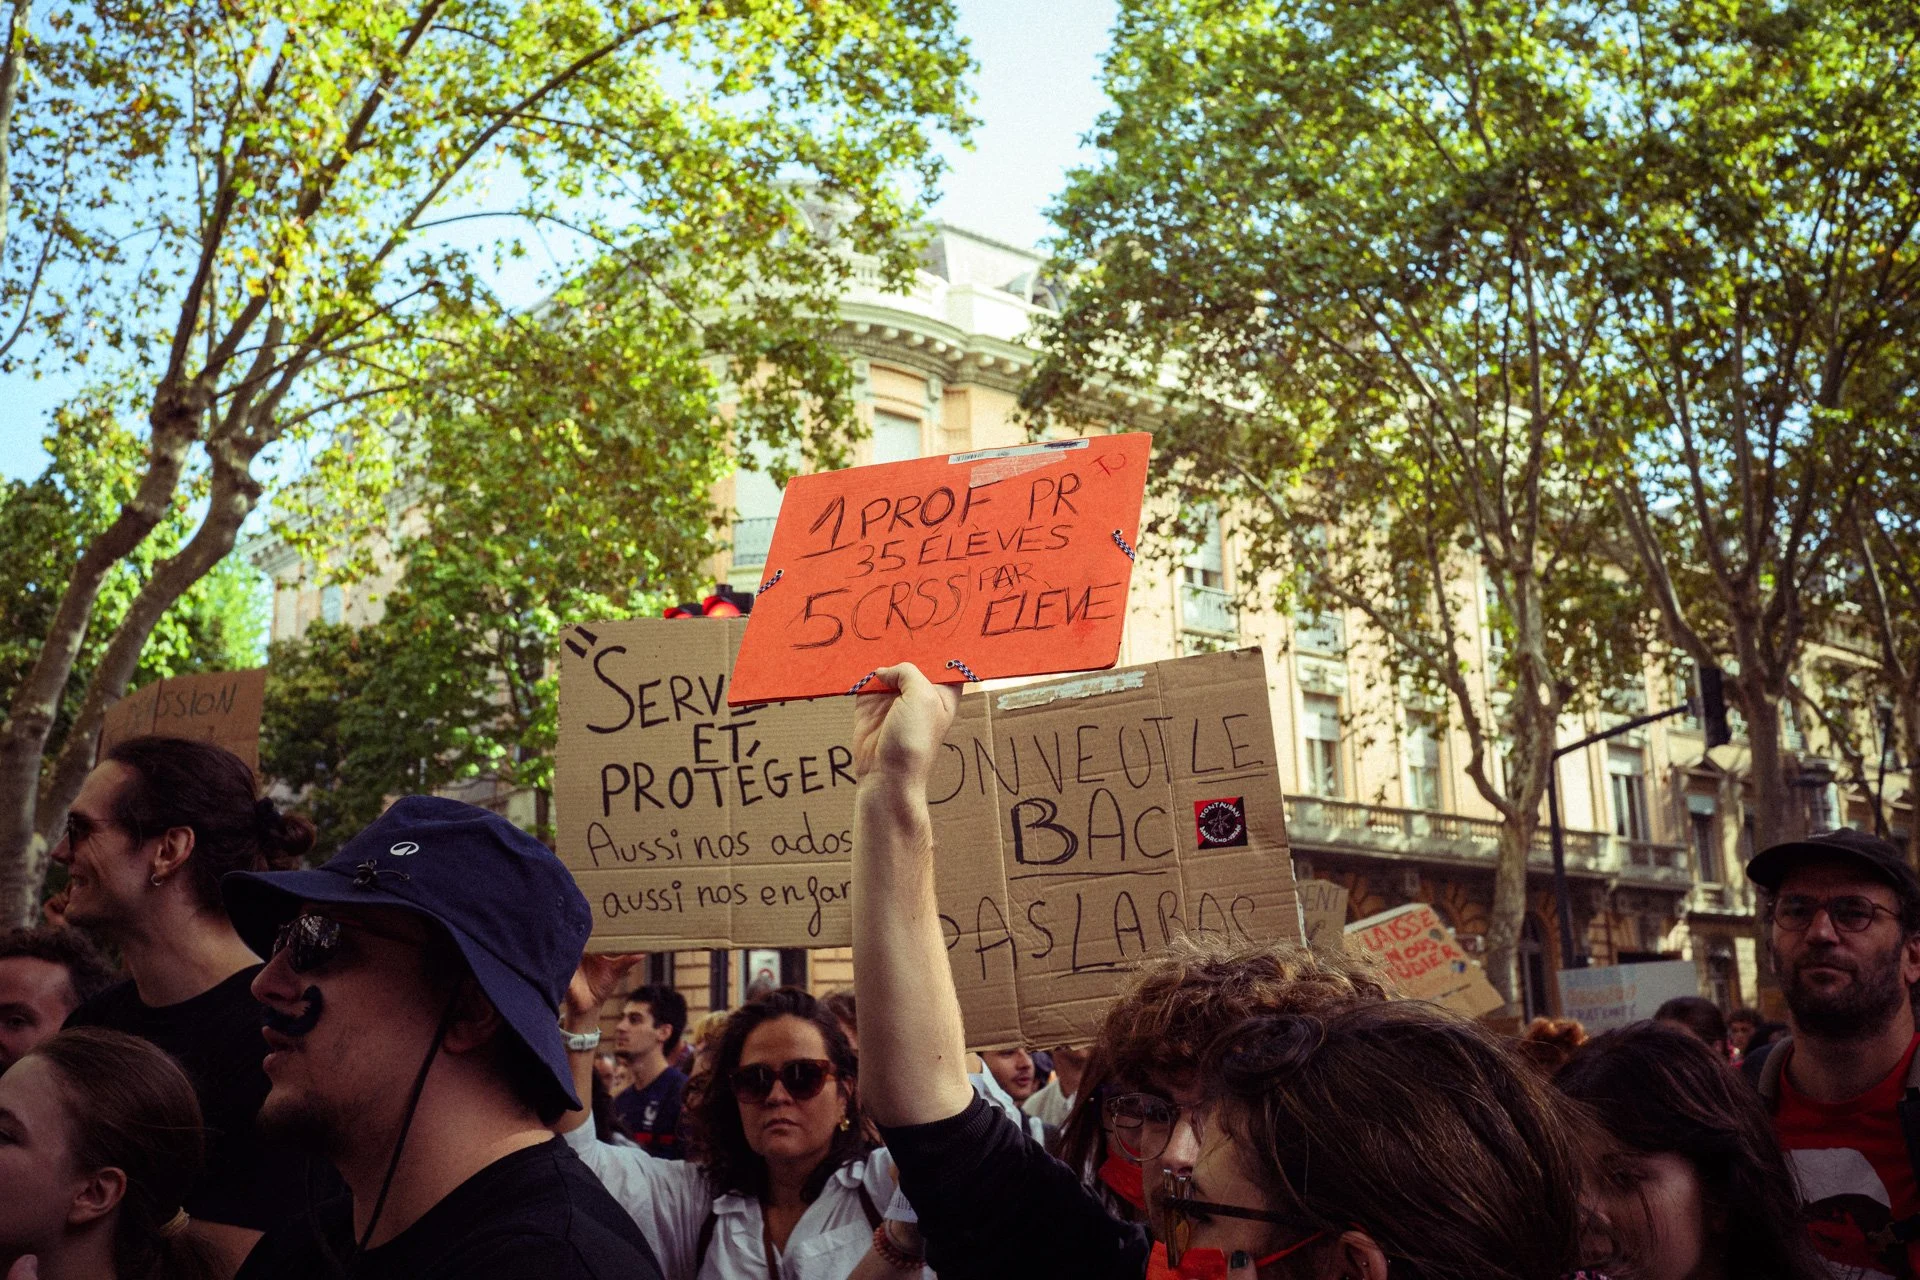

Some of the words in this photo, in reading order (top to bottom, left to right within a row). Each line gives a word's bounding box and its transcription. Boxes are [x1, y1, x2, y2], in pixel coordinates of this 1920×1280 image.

[795, 496, 856, 561] 1
[860, 480, 1003, 540] PROF
[1028, 473, 1082, 522] PR
[847, 539, 907, 579] 35
[917, 523, 1074, 566] ÉLÈVES
[786, 585, 852, 650] 5
[981, 581, 1122, 637] ÉLÈVE
[693, 720, 757, 765] ET
[1033, 715, 1174, 794] VEUT
[1192, 713, 1264, 775] LE
[601, 741, 857, 817] PROTÉGER
[1199, 801, 1241, 819] MONTAUBAN
[587, 822, 683, 867] Aussi
[694, 831, 750, 862] nos
[771, 811, 852, 856] ados
[1011, 787, 1175, 866] BAC
[603, 880, 684, 919] aussi
[697, 883, 748, 908] nos
[1072, 890, 1146, 974] LA
